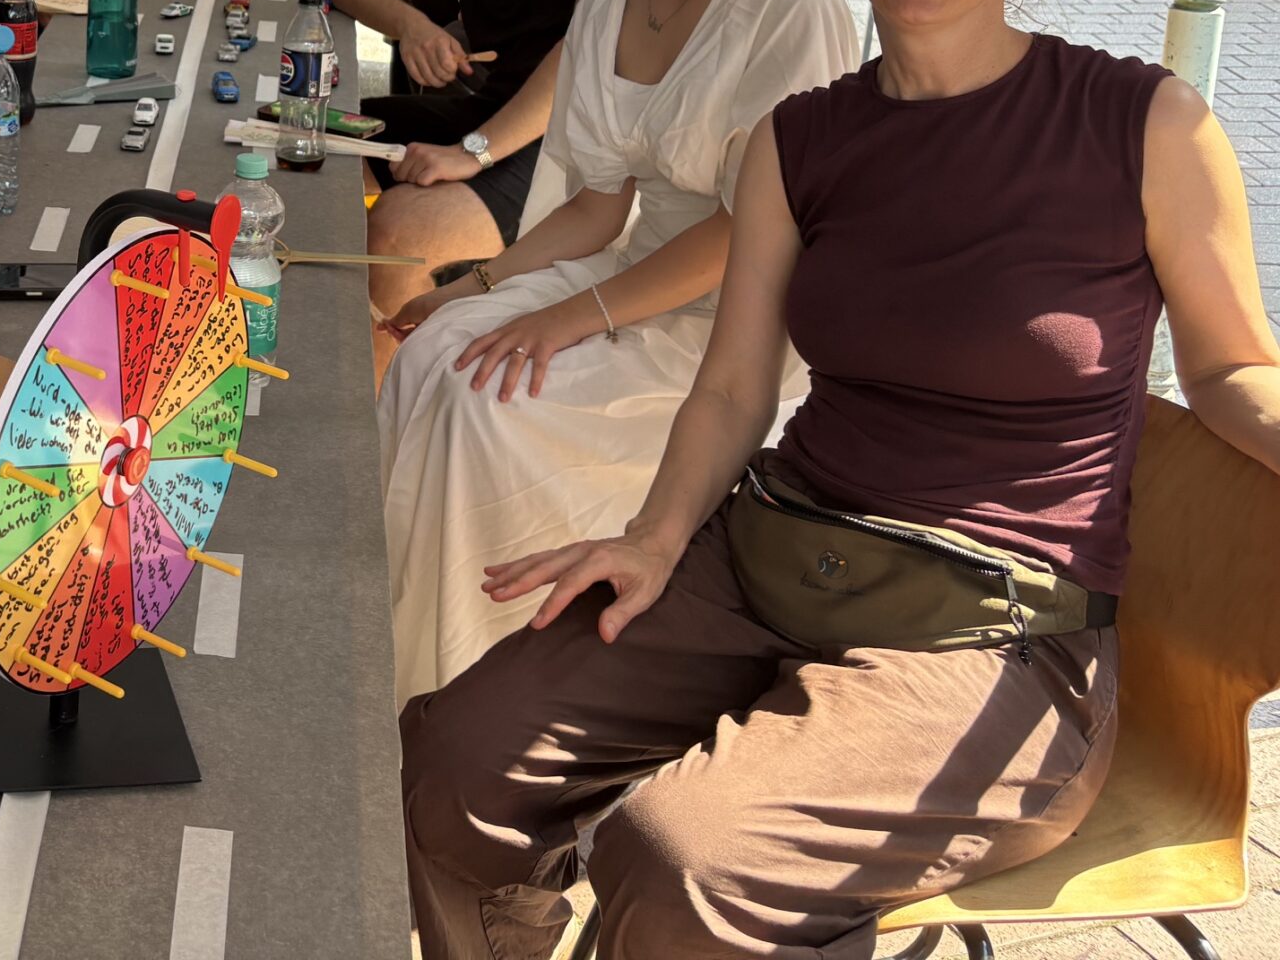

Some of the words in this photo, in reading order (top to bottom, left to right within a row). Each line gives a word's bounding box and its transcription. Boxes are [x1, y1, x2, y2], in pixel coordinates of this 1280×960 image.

[152, 329, 180, 375] genug
[217, 332, 244, 365] Was
[132, 342, 154, 396] Essen
[187, 363, 215, 392] kann
[164, 396, 181, 418] der
[9, 422, 37, 450] lieber
[85, 417, 102, 443] Süd
[217, 427, 237, 445] Was
[181, 437, 213, 455] macht
[56, 511, 79, 535] Tag
[23, 567, 55, 612] Esen
[28, 600, 68, 683] Sadtteil
